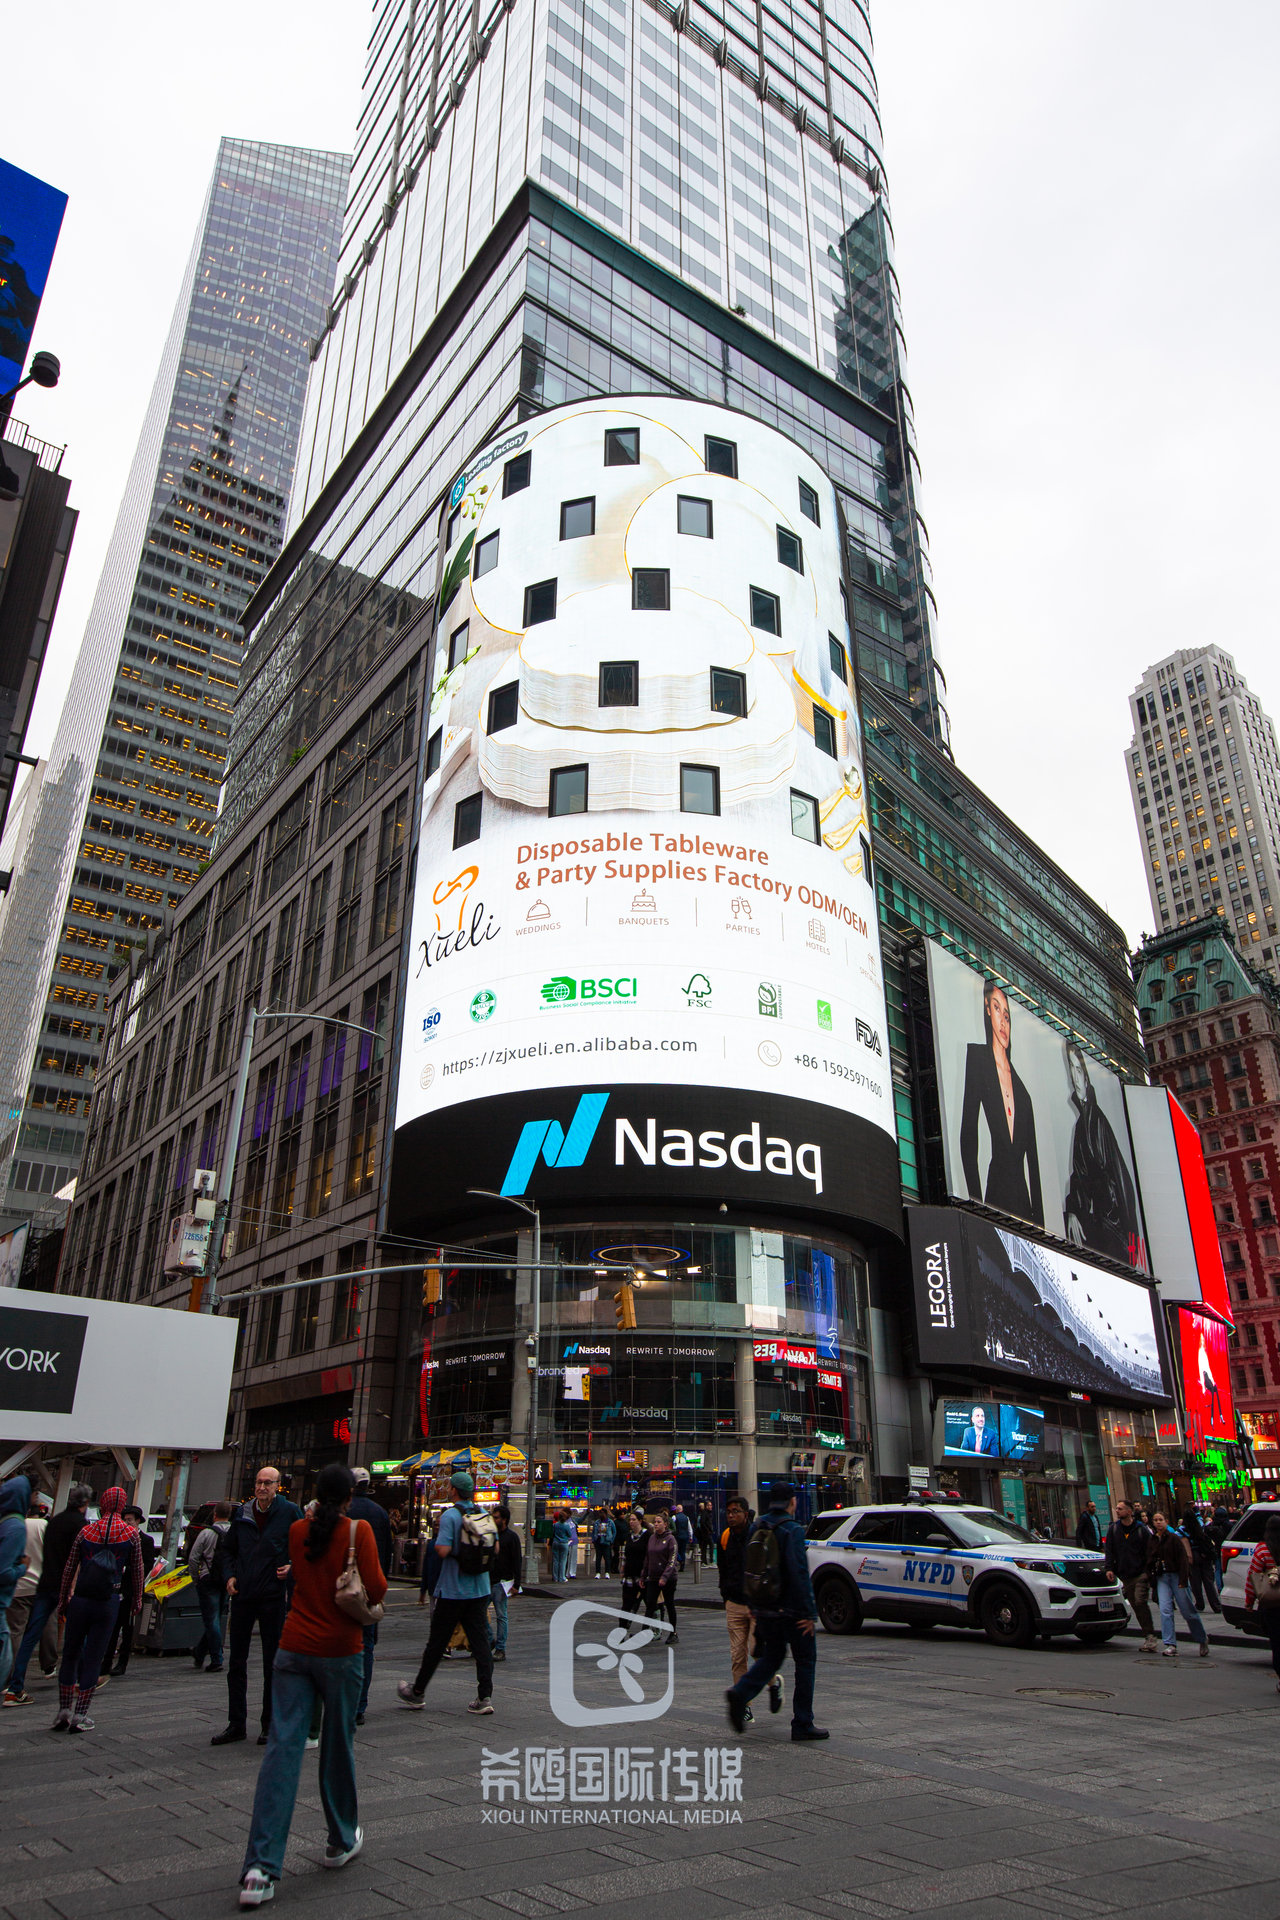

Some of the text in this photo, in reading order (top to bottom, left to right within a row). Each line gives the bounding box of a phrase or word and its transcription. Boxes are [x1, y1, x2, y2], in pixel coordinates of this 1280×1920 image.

[493, 434, 525, 458] factory
[516, 832, 769, 865] Disposable Tableware
[515, 859, 868, 939] & Party Supplies Factory ODM/OEM
[515, 922, 562, 936] WEDDINGS
[618, 917, 670, 926] BANQUETS
[725, 923, 761, 936] PARTIES
[805, 941, 831, 956] HOTELS
[580, 977, 637, 999] BSCI
[687, 999, 713, 1008] FSC
[761, 1006, 775, 1016] BPI
[422, 1011, 441, 1032] ISO
[855, 1017, 882, 1057] FDA
[442, 1036, 697, 1076] https://zjxueli.en.alibaba.com
[794, 1054, 882, 1098] +86 15925971600
[615, 1118, 823, 1195] Nasdaq
[925, 1242, 948, 1328] LEGORA
[578, 1345, 611, 1356] Nasdaq
[626, 1347, 716, 1356] REWRITE TOMORROW
[445, 1356, 467, 1366] REWRITE
[623, 1406, 669, 1421] Nasdaq
[983, 1553, 1005, 1561] POLICE
[902, 1560, 955, 1586] NYPD
